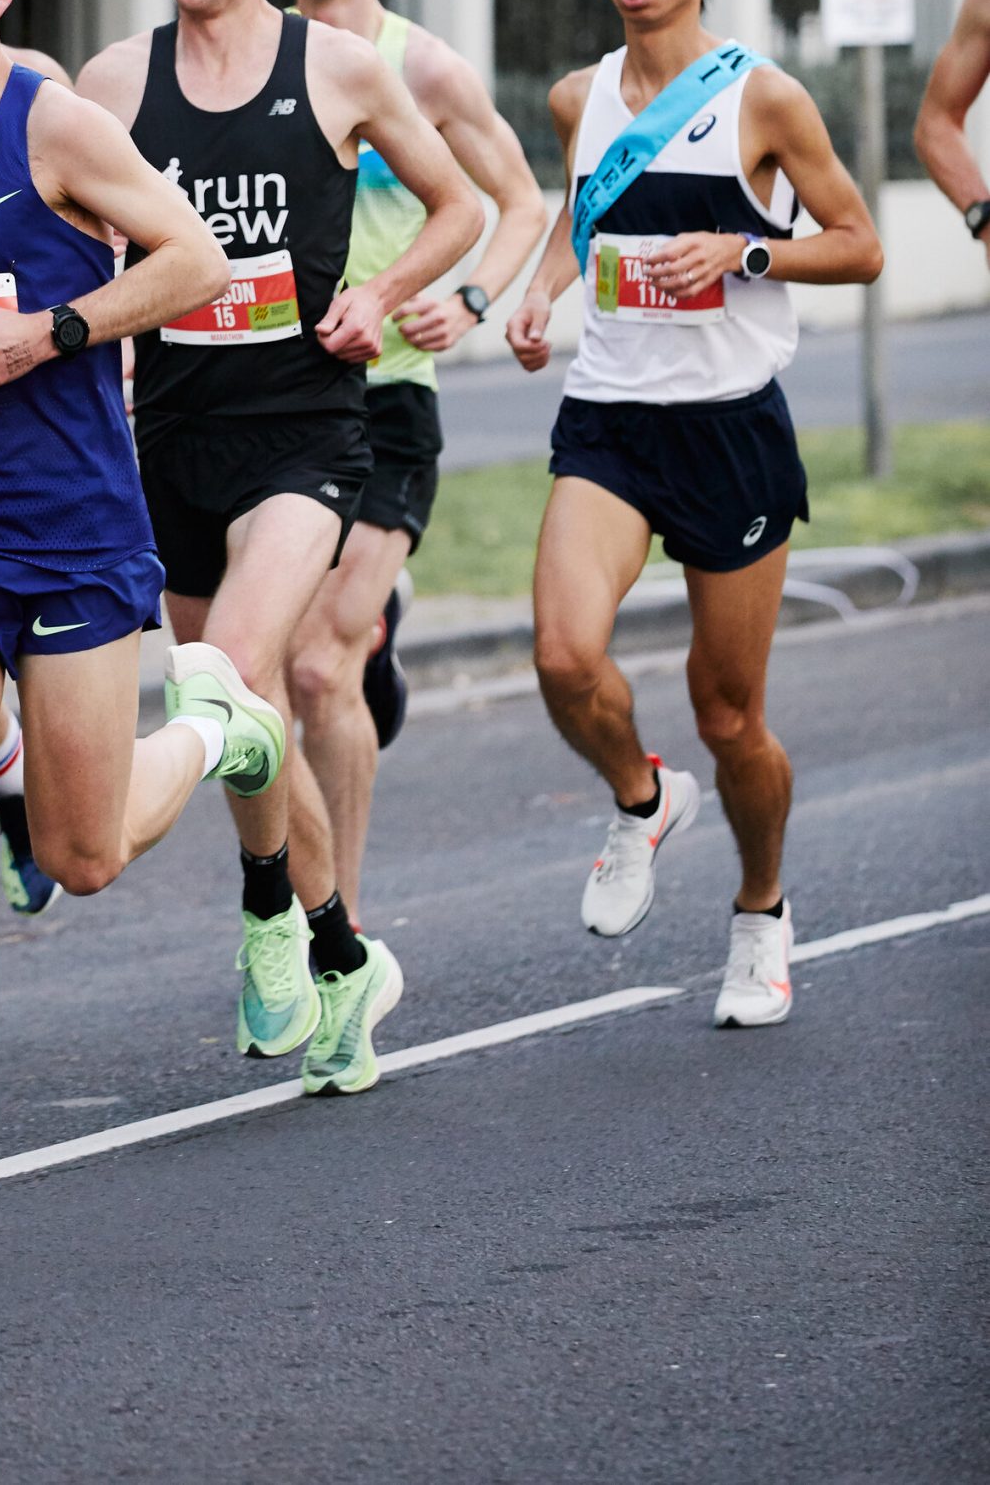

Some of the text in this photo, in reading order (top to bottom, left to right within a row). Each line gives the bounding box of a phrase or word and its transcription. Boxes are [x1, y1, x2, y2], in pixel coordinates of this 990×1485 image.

[194, 173, 287, 213] run
[210, 281, 257, 305] SON
[213, 306, 236, 328] 15
